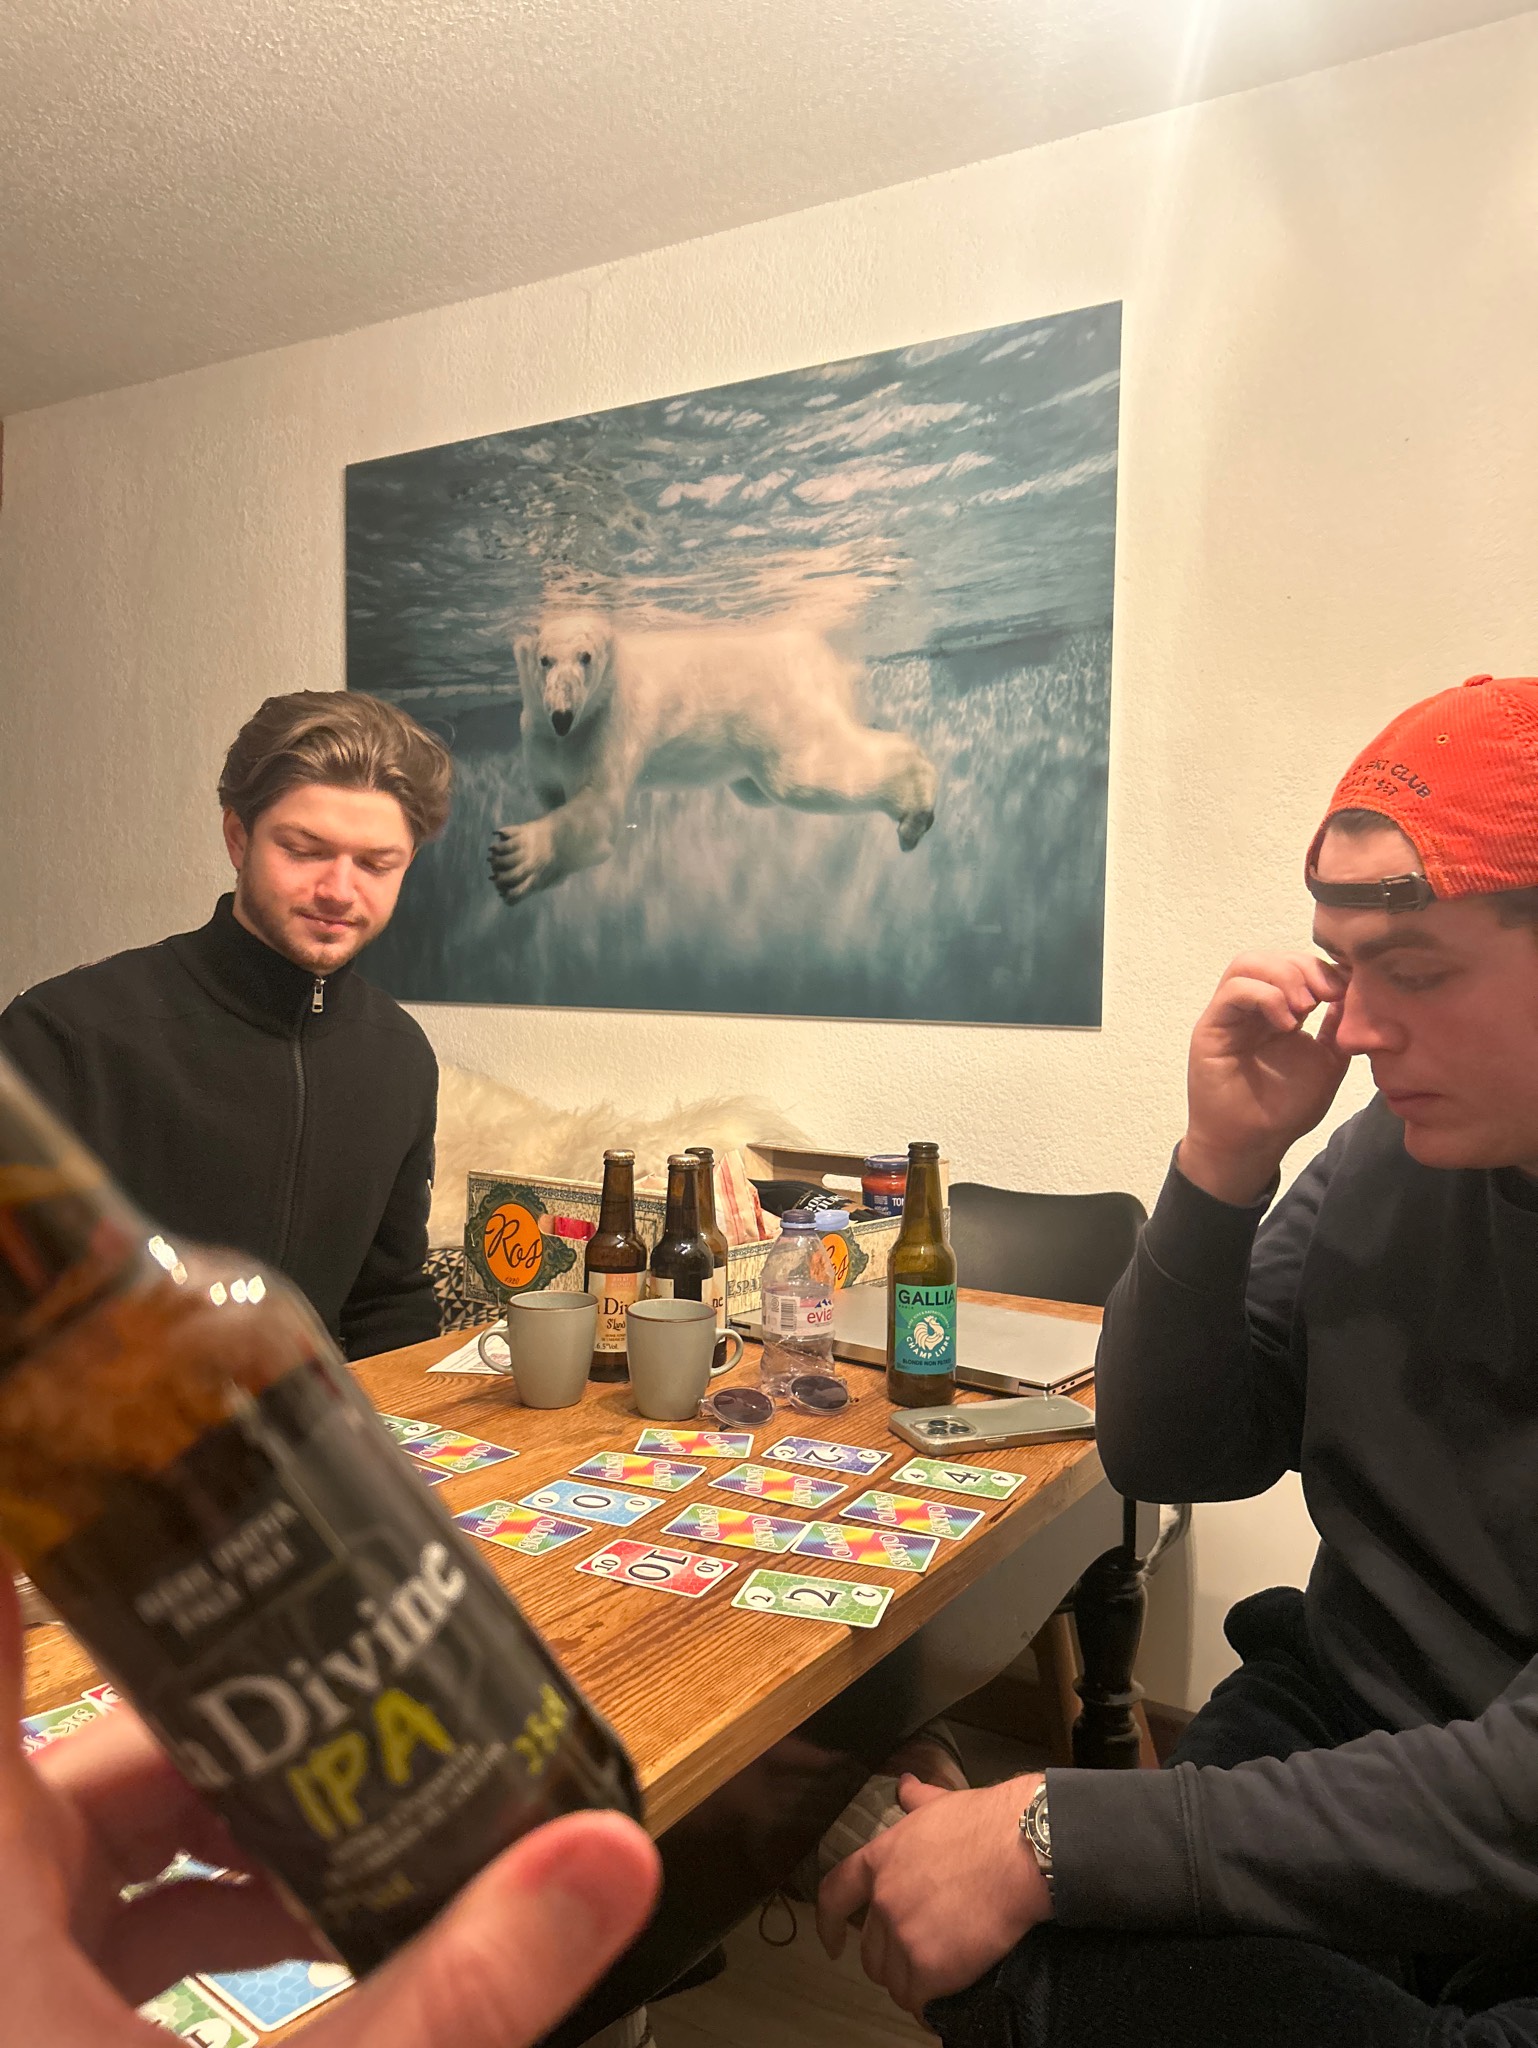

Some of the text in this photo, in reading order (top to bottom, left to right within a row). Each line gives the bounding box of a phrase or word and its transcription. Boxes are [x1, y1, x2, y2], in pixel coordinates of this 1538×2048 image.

[1390, 763, 1431, 798] CLUB
[898, 1289, 956, 1306] GALLIA
[807, 1308, 833, 1324] evia
[906, 1335, 950, 1359] CHAMP LIBRE
[601, 1453, 625, 1479] SKYJO
[653, 1462, 676, 1488] SKYJO
[740, 1466, 767, 1494] SKYJO
[944, 1471, 981, 1484] 4
[572, 1494, 611, 1509] 0
[791, 1478, 817, 1504] SKYJO
[475, 1505, 515, 1535] SKYJO
[872, 1494, 897, 1523] SKYJO
[926, 1505, 954, 1535] SKYJO
[518, 1519, 557, 1550] SKYJO
[695, 1508, 720, 1539] SKYJO
[752, 1517, 778, 1548] SKYJO
[819, 1525, 853, 1558] SKYJO
[879, 1534, 916, 1567] SKYJO
[595, 1559, 618, 1571] 10
[628, 1550, 688, 1581] 10
[696, 1561, 720, 1573] 10
[785, 1587, 842, 1607] 2
[193, 1540, 466, 1777] Divine
[287, 1687, 455, 1841] IPA
